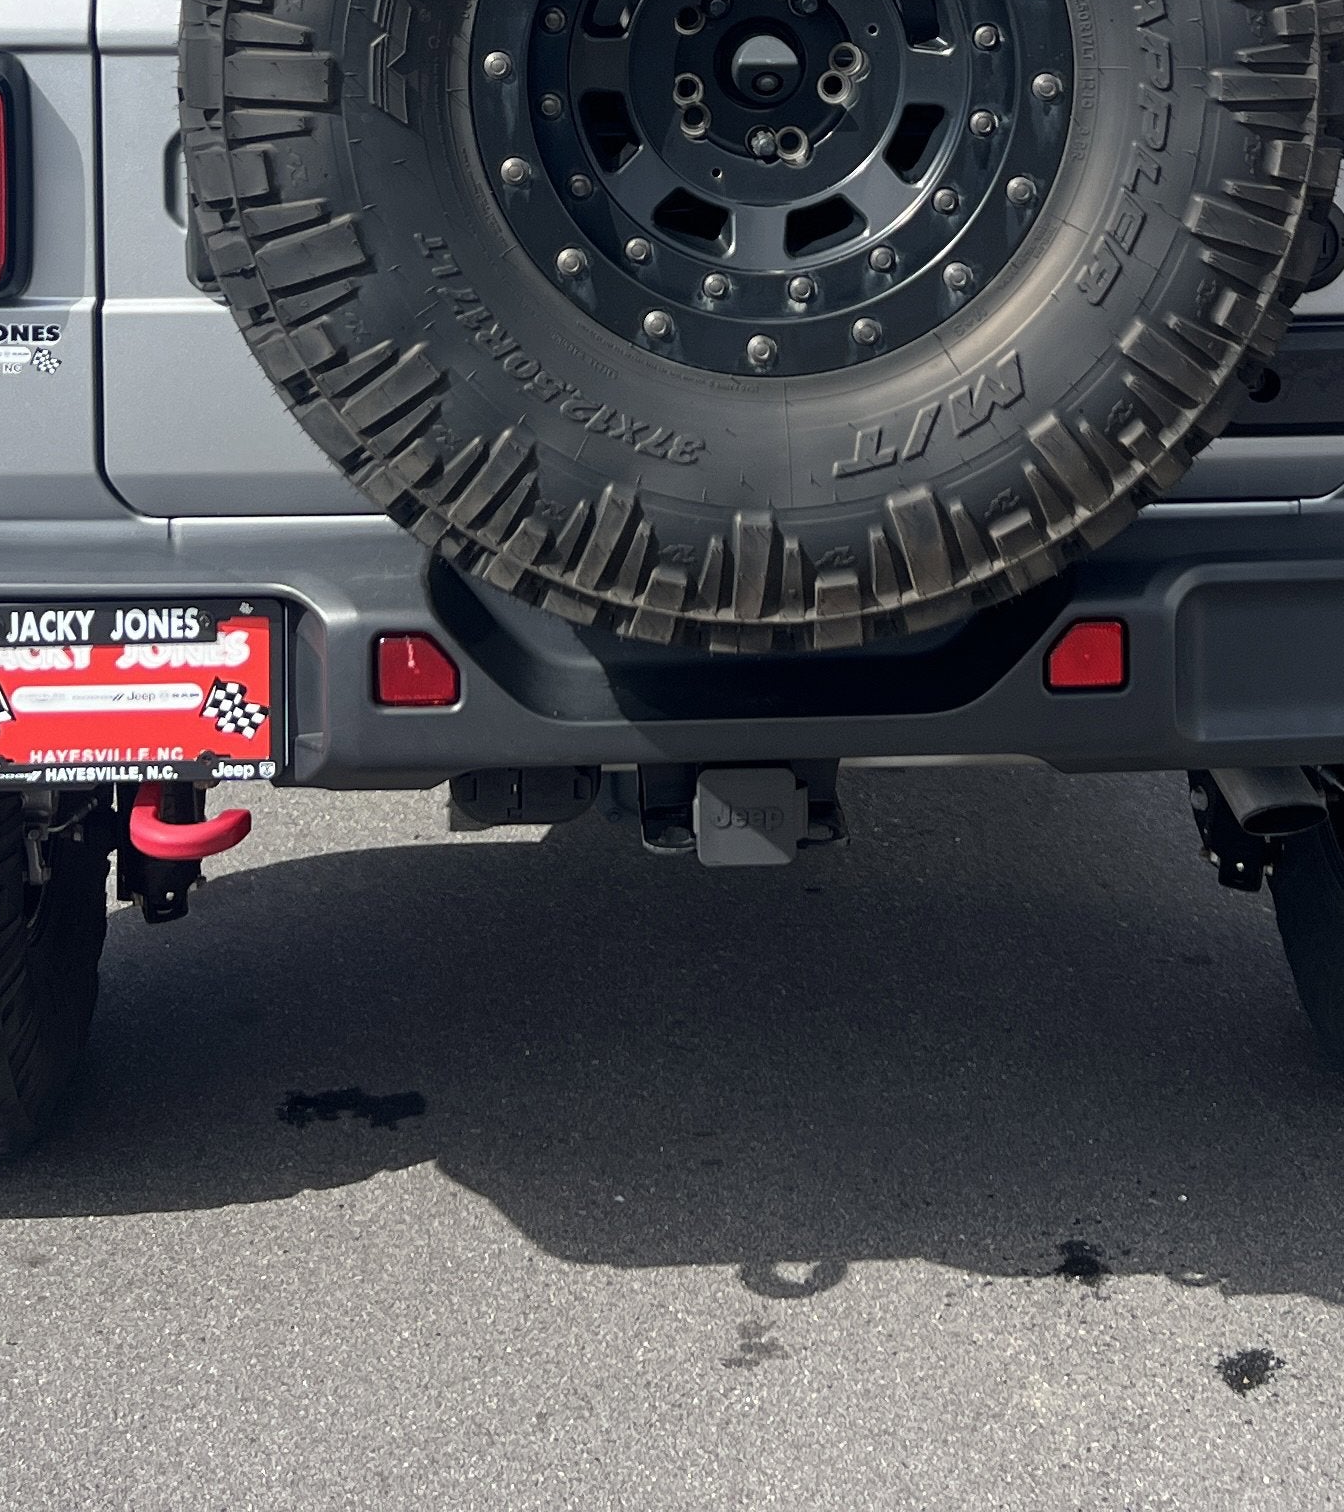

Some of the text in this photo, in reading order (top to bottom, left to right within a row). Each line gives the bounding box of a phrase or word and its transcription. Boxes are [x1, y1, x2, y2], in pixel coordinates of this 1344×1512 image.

[4, 362, 22, 373] NC
[832, 348, 1026, 479] M/T
[6, 607, 200, 642] JACKY JONES
[127, 690, 156, 703] Jeep
[44, 766, 144, 783] HAYESVILLE,
[146, 766, 179, 781] N.C.
[211, 761, 255, 779] Jeep
[713, 804, 785, 831] Jeep
